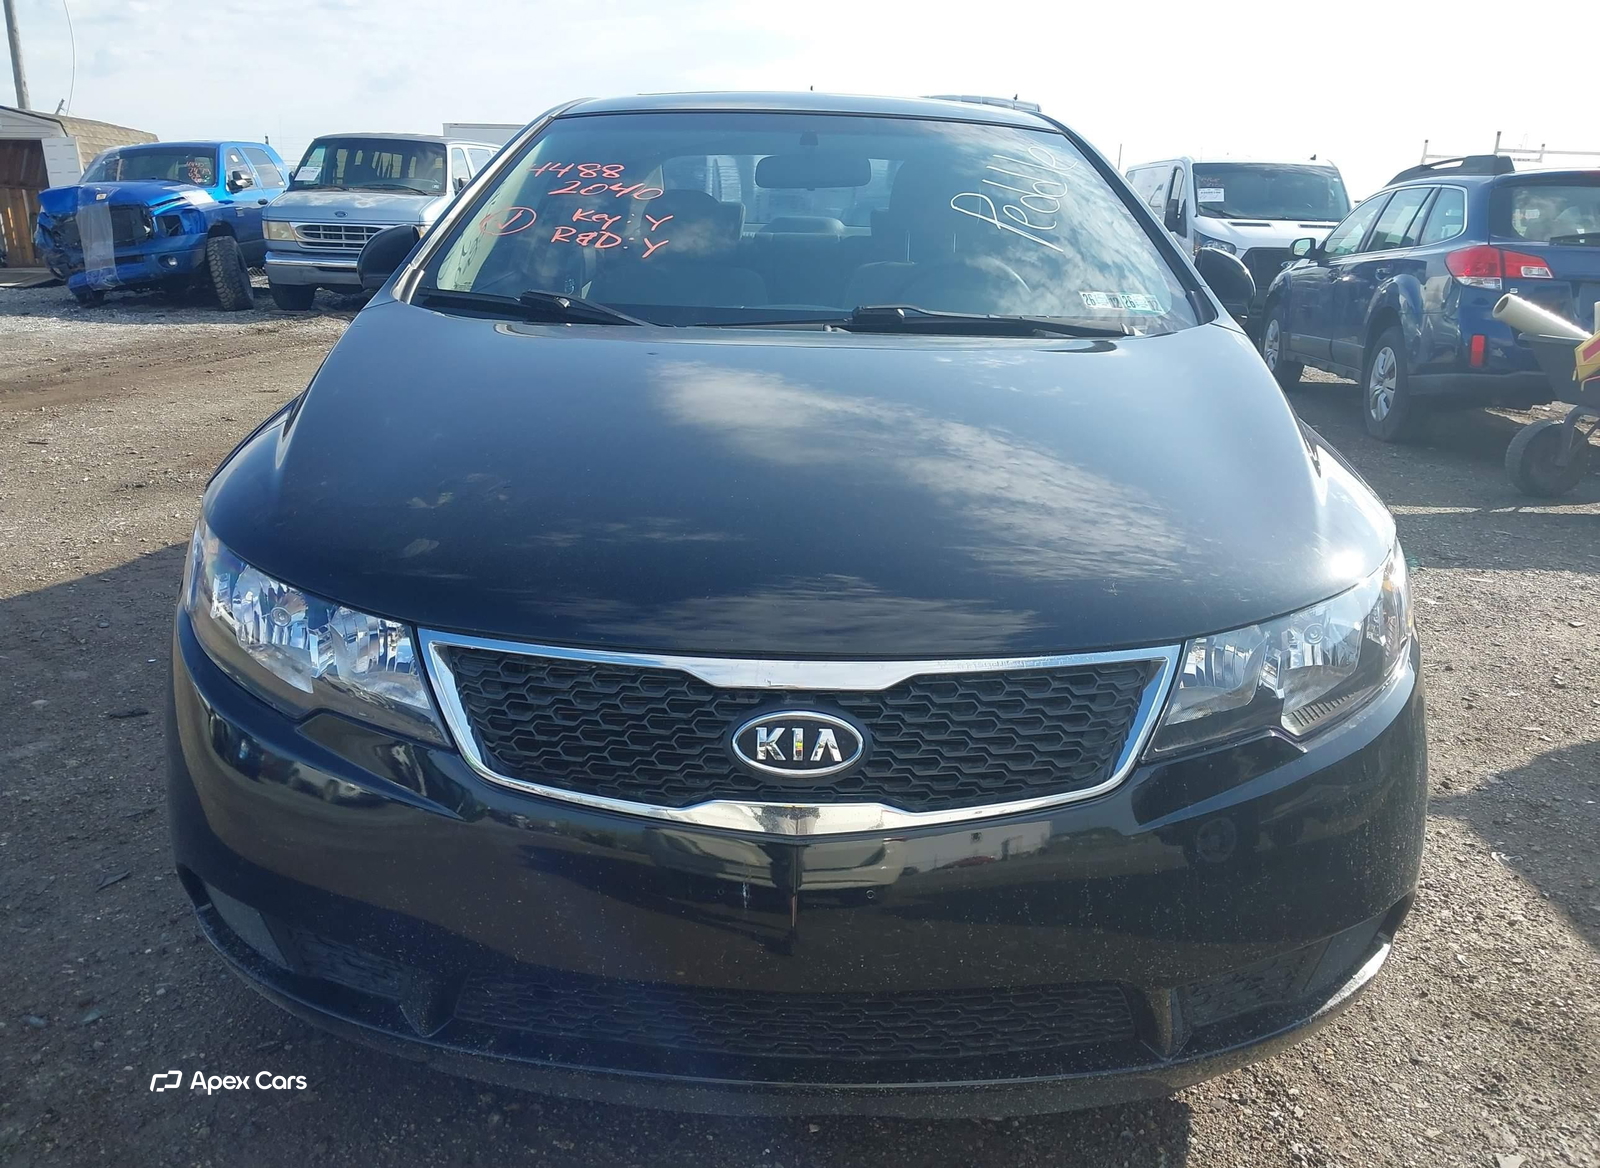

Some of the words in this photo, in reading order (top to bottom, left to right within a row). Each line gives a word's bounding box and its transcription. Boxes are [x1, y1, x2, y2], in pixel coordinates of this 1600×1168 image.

[527, 162, 625, 178] 4488
[548, 180, 665, 200] 2040
[645, 214, 674, 231] Y
[642, 237, 669, 258] Y
[1082, 293, 1097, 306] 26
[1122, 295, 1136, 308] 26
[755, 727, 843, 761] KIA
